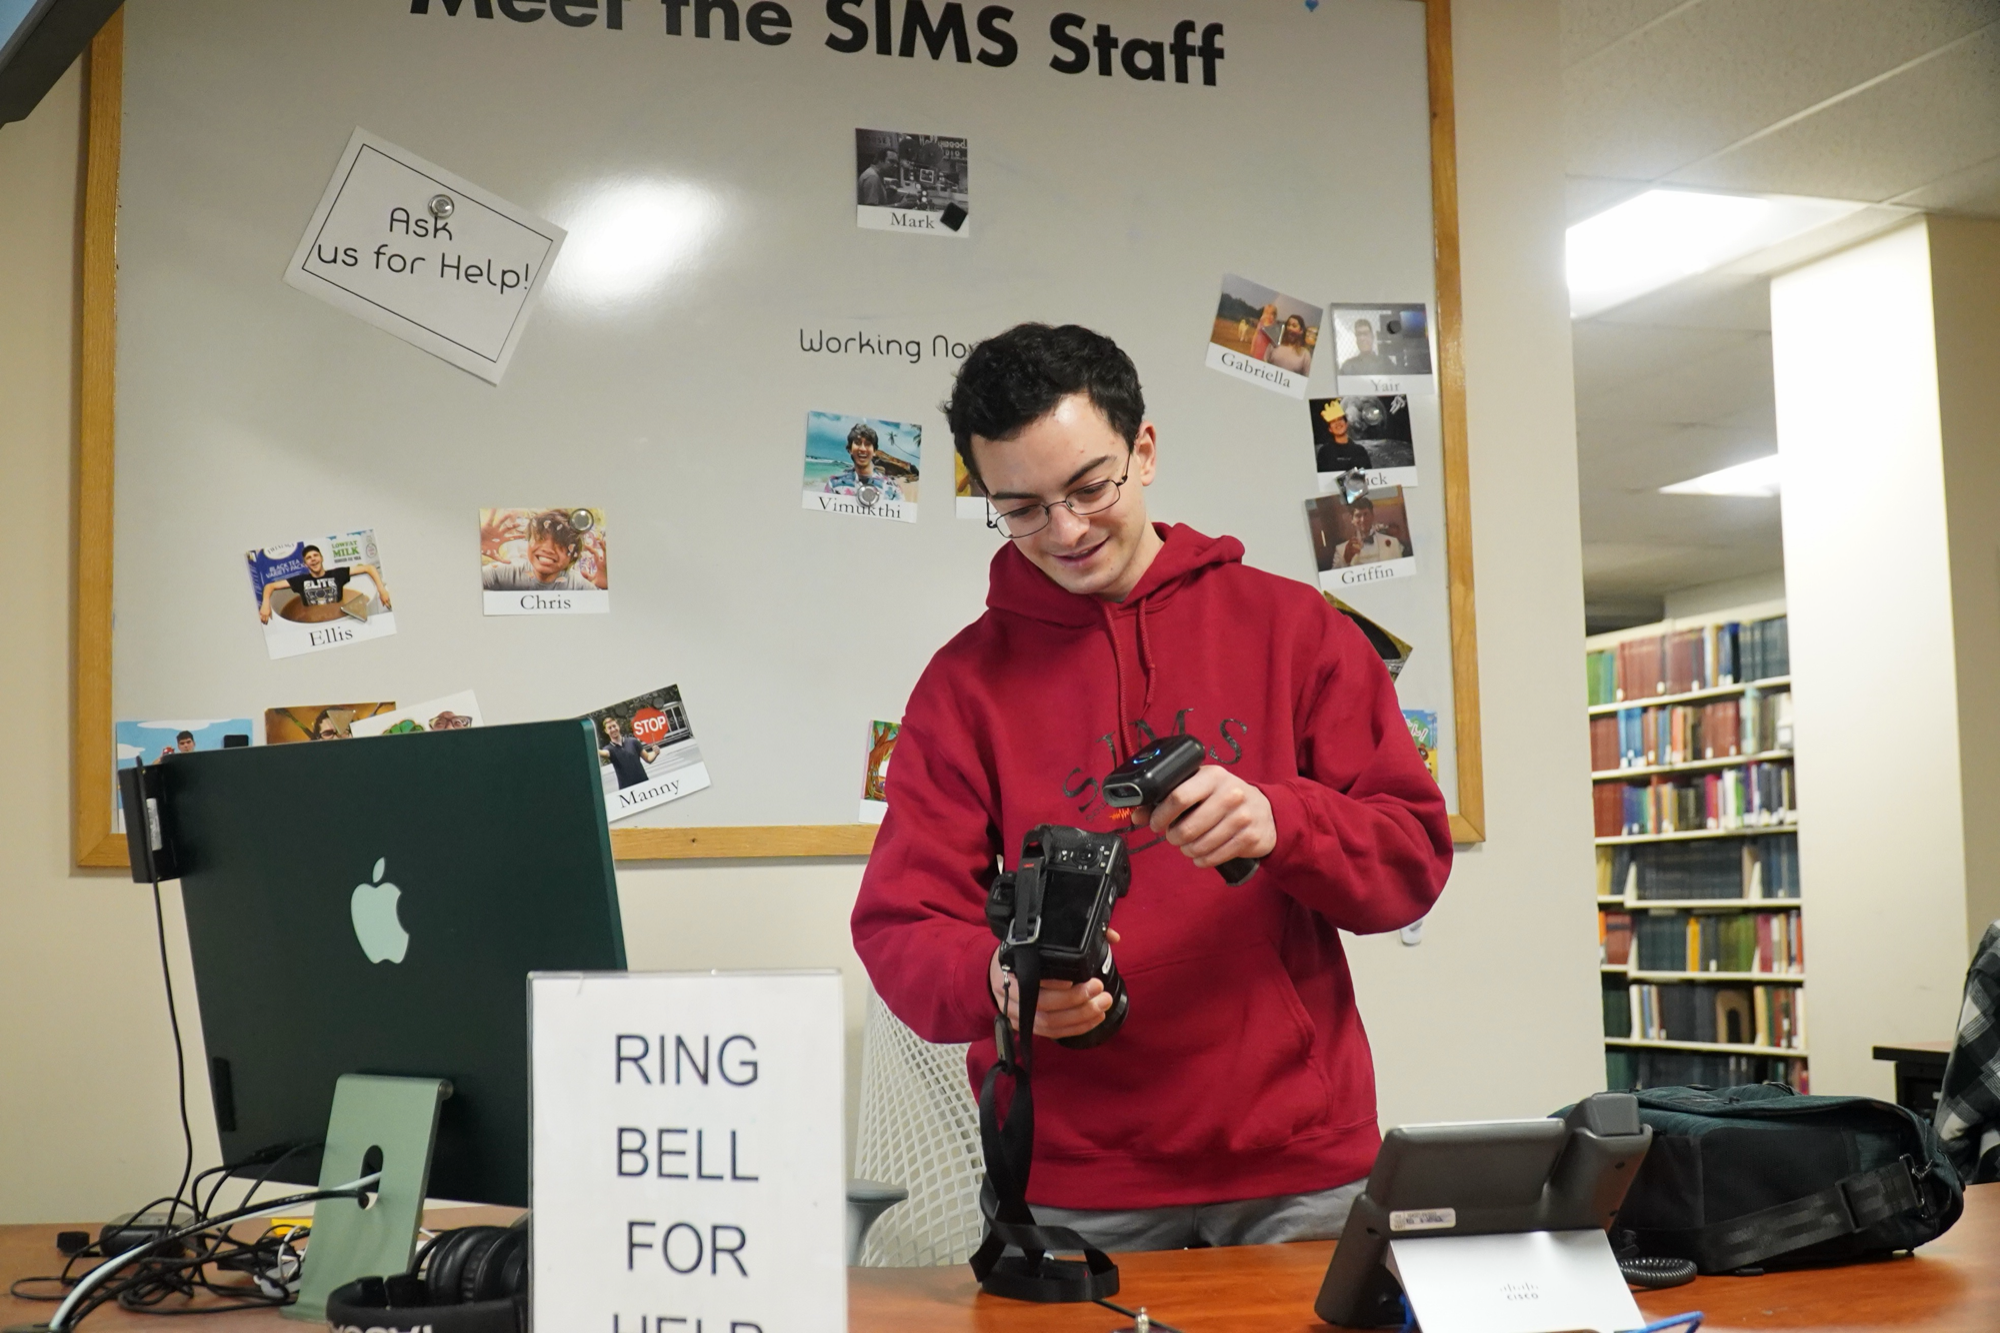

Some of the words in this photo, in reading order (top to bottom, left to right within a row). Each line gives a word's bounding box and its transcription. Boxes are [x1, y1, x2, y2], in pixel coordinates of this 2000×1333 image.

[661, 0, 793, 46] the
[825, 0, 1018, 67] SIMS
[1049, 13, 1225, 86] Staff
[390, 207, 452, 241] Ask
[891, 212, 935, 229] Mark
[317, 244, 359, 267] us
[373, 244, 426, 274] for
[440, 252, 529, 294] Help!
[800, 329, 920, 363] Working
[933, 335, 973, 358] No
[1221, 351, 1291, 388] Gabriella
[1371, 379, 1400, 393] Yair
[1366, 472, 1389, 487] ick
[818, 496, 901, 518] Vimukthi
[332, 546, 360, 558] MILK
[1341, 565, 1394, 585] Griffin
[520, 594, 571, 610] Chris
[309, 626, 353, 647] Ellis
[633, 715, 666, 736] STOP
[619, 779, 680, 808] Manny
[615, 1034, 758, 1087] RING
[616, 1127, 759, 1182] BELL
[627, 1220, 749, 1278] FOR
